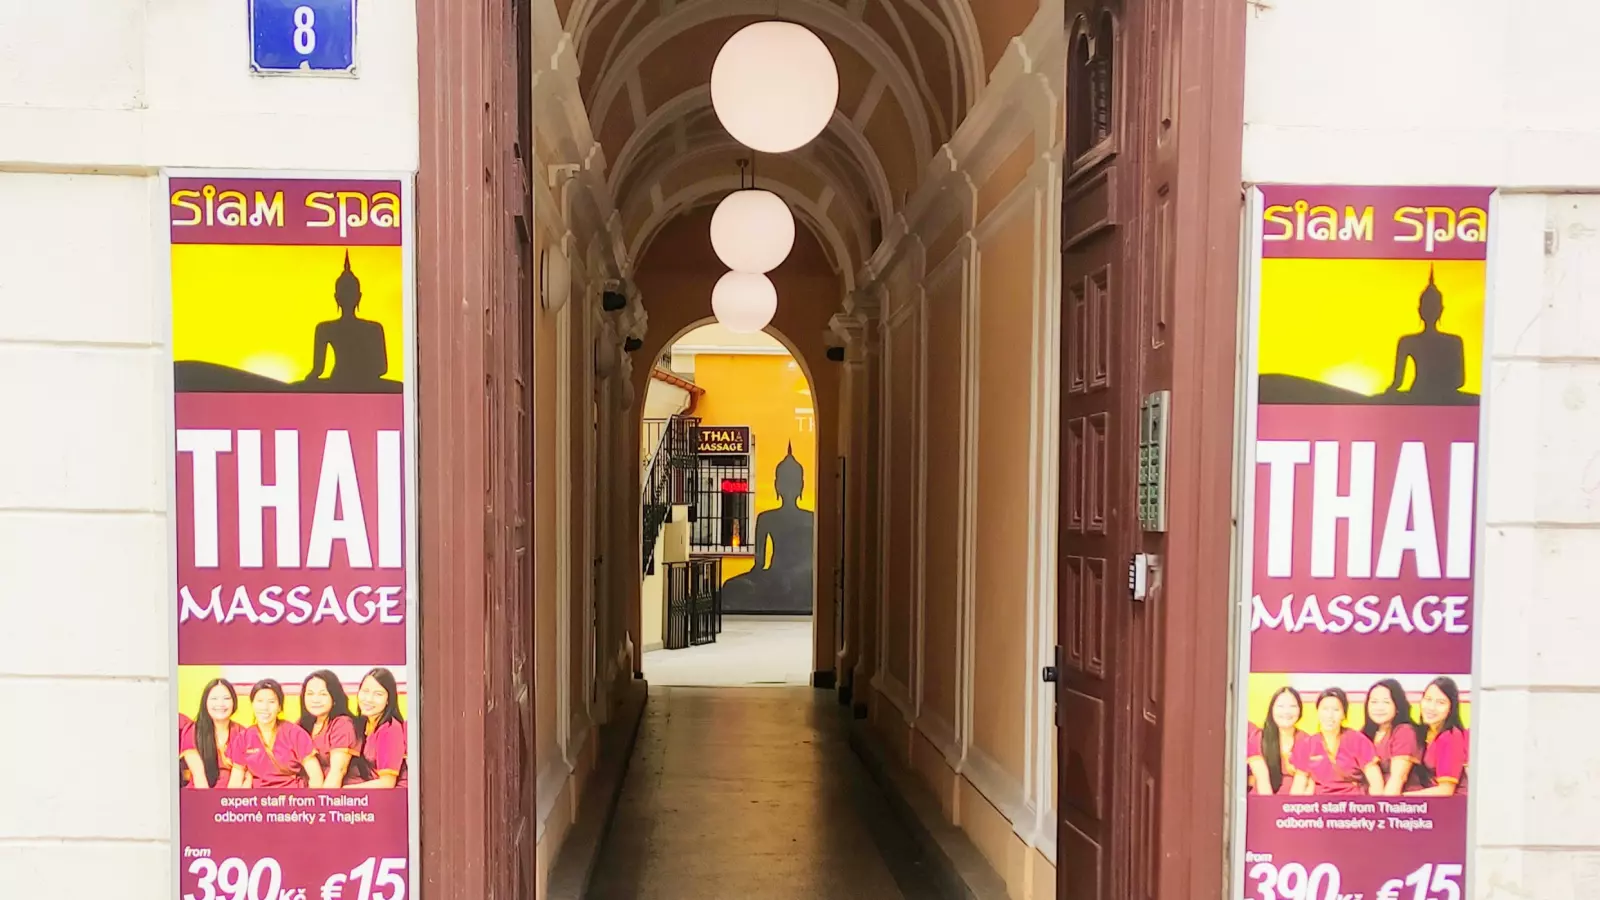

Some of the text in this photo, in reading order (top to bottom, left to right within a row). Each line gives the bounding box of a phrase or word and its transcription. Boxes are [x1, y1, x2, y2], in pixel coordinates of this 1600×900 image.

[293, 5, 316, 55] 8
[701, 430, 735, 442] THAI
[176, 429, 402, 568] THAI
[1256, 440, 1475, 578] THAI
[178, 584, 404, 625] MASSAGE
[1250, 593, 1470, 634] MASSAGE
[220, 794, 369, 808] expert staff from Thailand
[1282, 801, 1428, 815] expert staff from Thailand
[214, 810, 375, 825] odborné masérky z Thajska
[1377, 819, 1386, 829] z
[1386, 816, 1433, 832] Thajska
[184, 846, 211, 857] from
